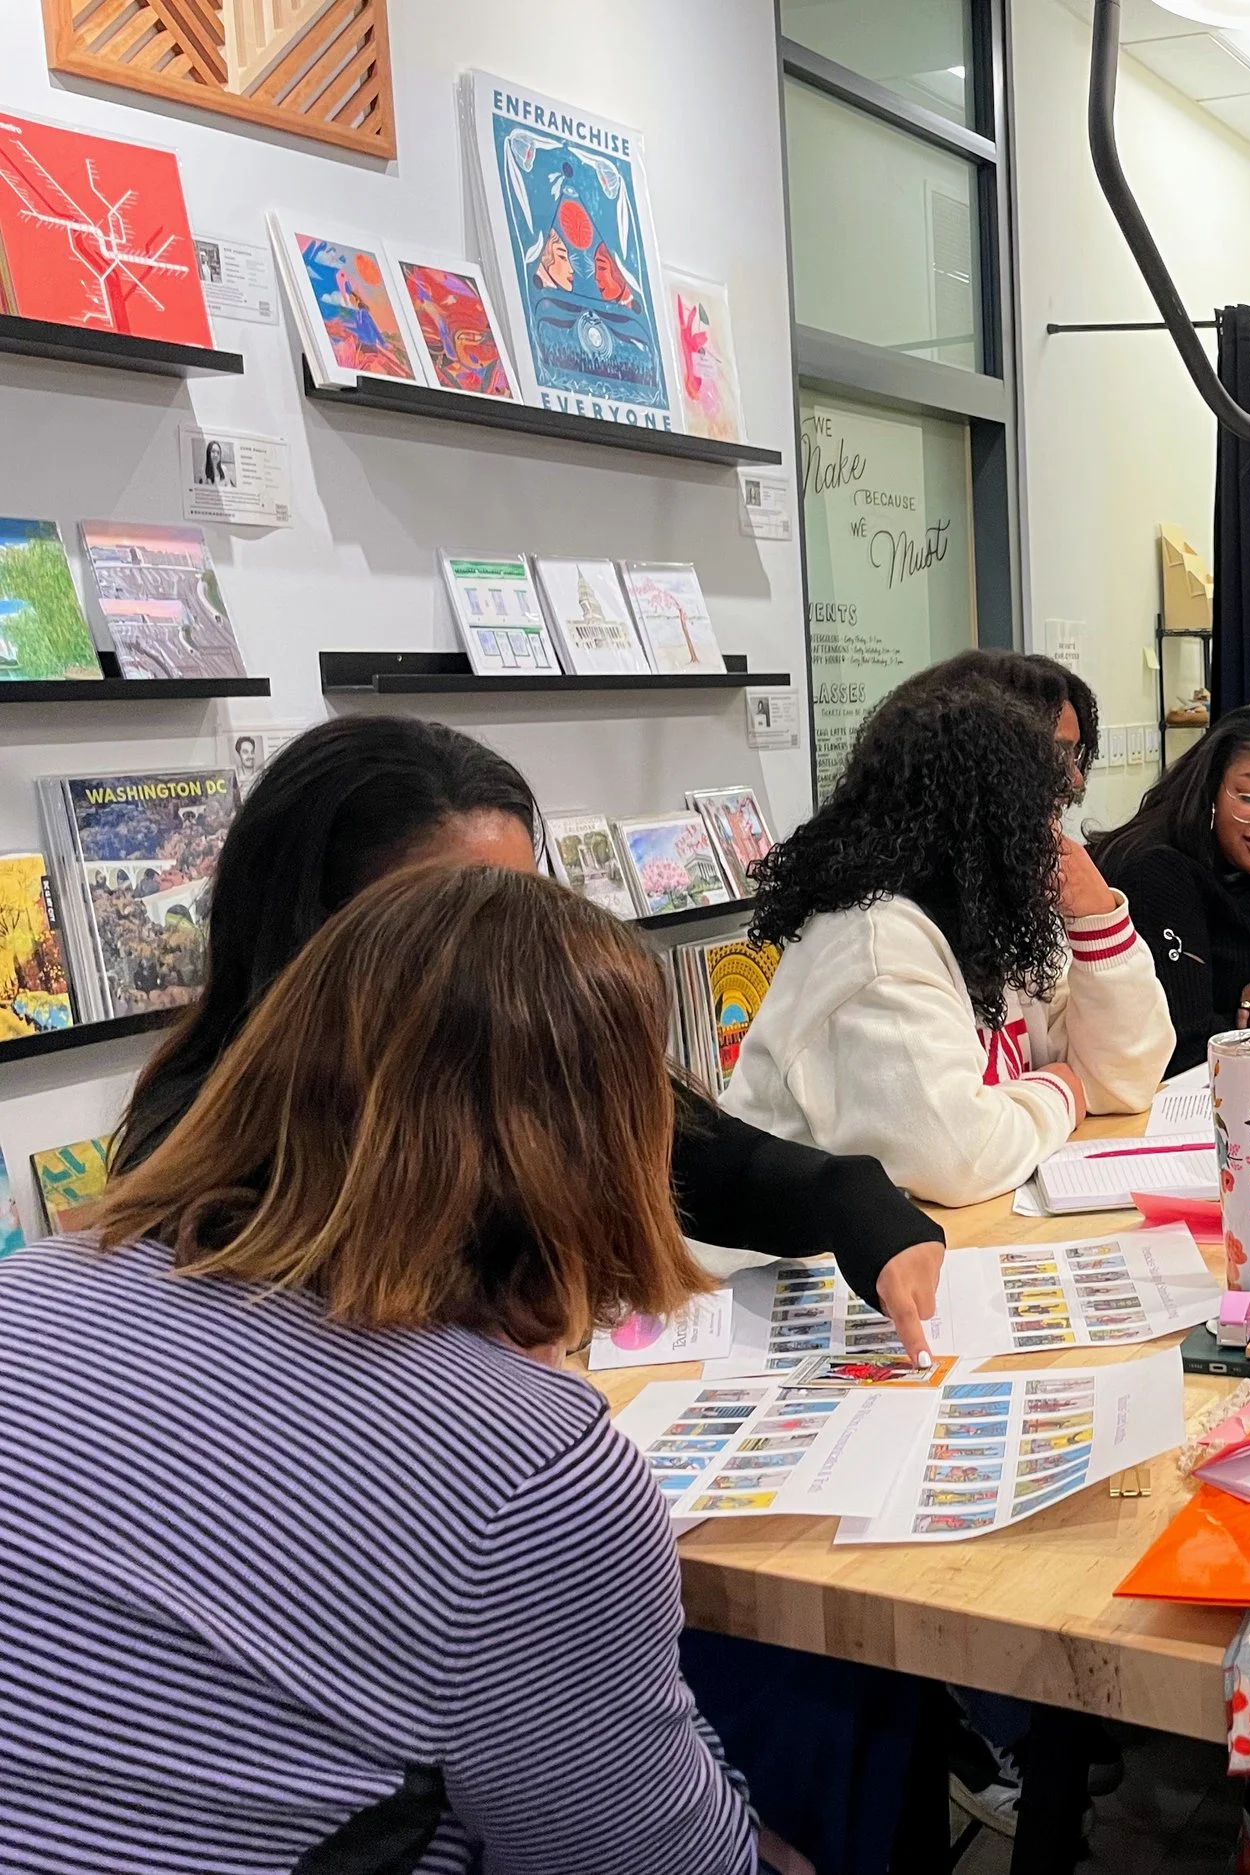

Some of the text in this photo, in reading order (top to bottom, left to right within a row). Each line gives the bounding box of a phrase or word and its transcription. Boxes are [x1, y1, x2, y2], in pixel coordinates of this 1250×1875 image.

[493, 89, 630, 157] ENFRANCHISE
[541, 392, 671, 432] EVERYONE
[802, 416, 832, 437] WE
[854, 489, 916, 511] BECAUSE
[850, 517, 867, 537] WE
[870, 519, 950, 590] Must
[809, 602, 857, 626] ENTS
[813, 683, 866, 704] ASSES
[86, 779, 227, 805] WASHINGTON DC
